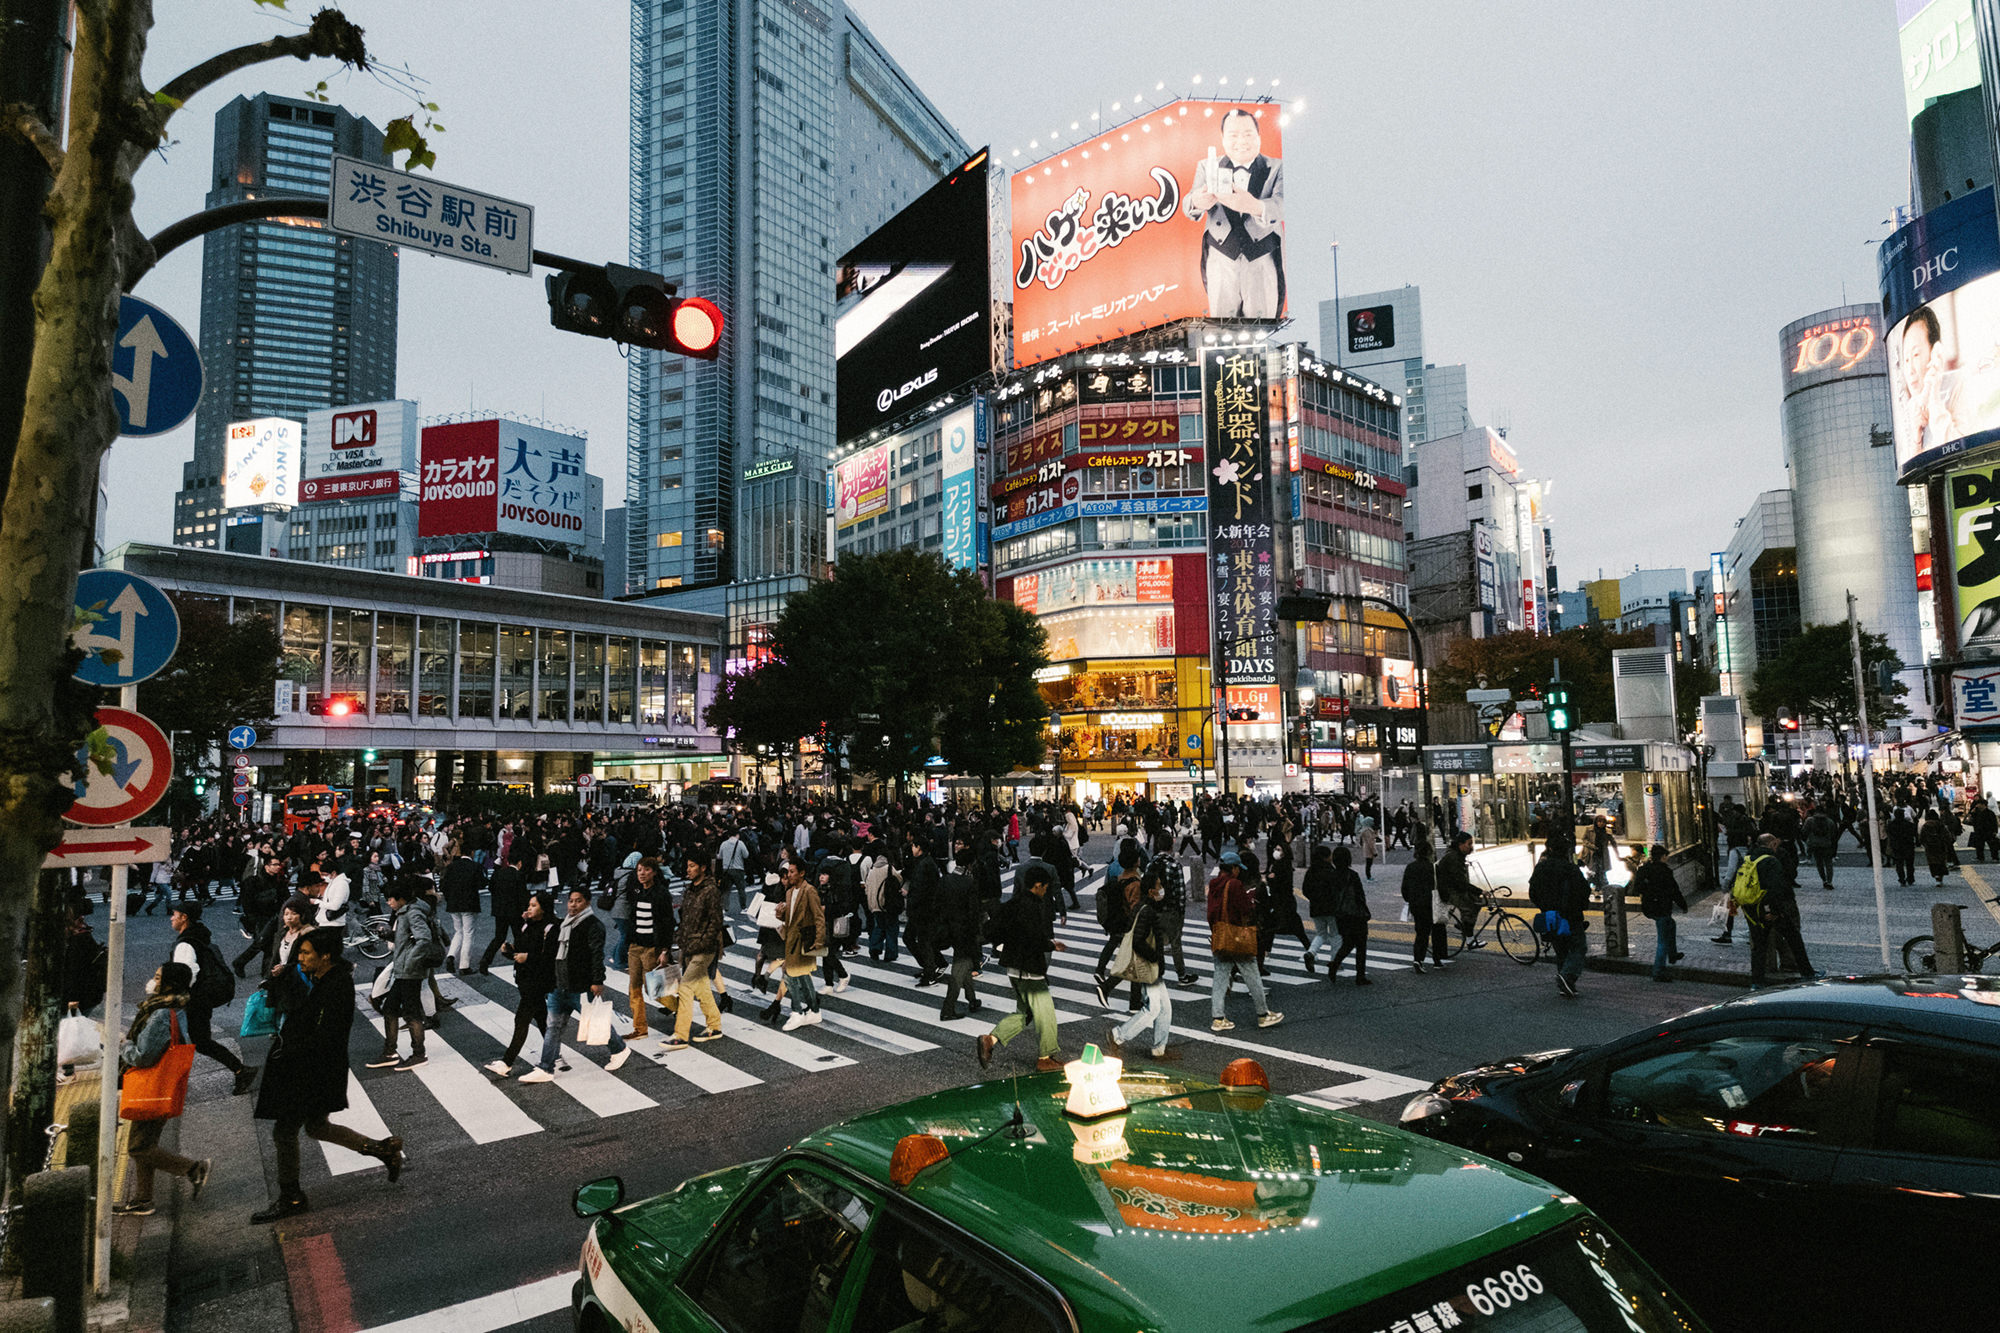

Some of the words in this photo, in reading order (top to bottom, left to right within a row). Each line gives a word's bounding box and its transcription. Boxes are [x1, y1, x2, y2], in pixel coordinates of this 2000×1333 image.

[349, 168, 518, 242] 渋谷駅前
[376, 213, 455, 249] Shibuya
[461, 234, 499, 259] Sta.
[1911, 246, 1959, 291] DHC
[1353, 335, 1375, 344] TOHO
[1803, 317, 1872, 338] SHIBUYA
[1353, 341, 1383, 350] CINEMAS
[1791, 326, 1876, 373] 109
[893, 368, 938, 401] LEXUS
[335, 414, 371, 446] DC
[1080, 420, 1176, 439] コンタクト
[1225, 353, 1261, 520] 和楽器バンド
[228, 429, 273, 482] SANKYO
[329, 452, 345, 462] DC
[345, 449, 364, 459] VISA
[369, 449, 376, 457] &
[503, 437, 584, 484] 大声
[1146, 449, 1193, 467] ガスト
[1942, 442, 1960, 455] DHC
[275, 426, 289, 497] SANKYO
[321, 462, 335, 472] DC
[336, 457, 382, 471] MasterCard
[423, 455, 496, 484] カラオケ
[744, 465, 769, 478] MARK
[770, 461, 793, 471] CITY
[843, 451, 887, 484] 品川スキン
[1038, 460, 1066, 483] ガスト
[323, 477, 393, 494] 三菱東京UFJ銀行
[422, 480, 496, 501] JOYSOUND
[843, 469, 887, 500] クリニック
[1355, 470, 1378, 490] ガスト
[996, 505, 1008, 520] 7F
[1025, 487, 1060, 515] ガスト
[1086, 503, 1113, 513] AEON
[1120, 499, 1205, 512] 英会話イーオン
[500, 502, 583, 531] JOYSOUND
[962, 480, 972, 567] コンタクト
[946, 485, 961, 577] アイシテ
[1214, 523, 1272, 539] 大新年会
[1478, 531, 1492, 555] OS
[1230, 538, 1256, 549] 2017
[1233, 550, 1258, 658] 東京体育館
[1218, 675, 1276, 684] agakkiband.jp
[1961, 678, 1998, 713] 堂
[1100, 713, 1164, 725] L'OCCITANE
[1432, 759, 1463, 769] 渋谷駅
[1466, 1264, 1544, 1316] 6686
